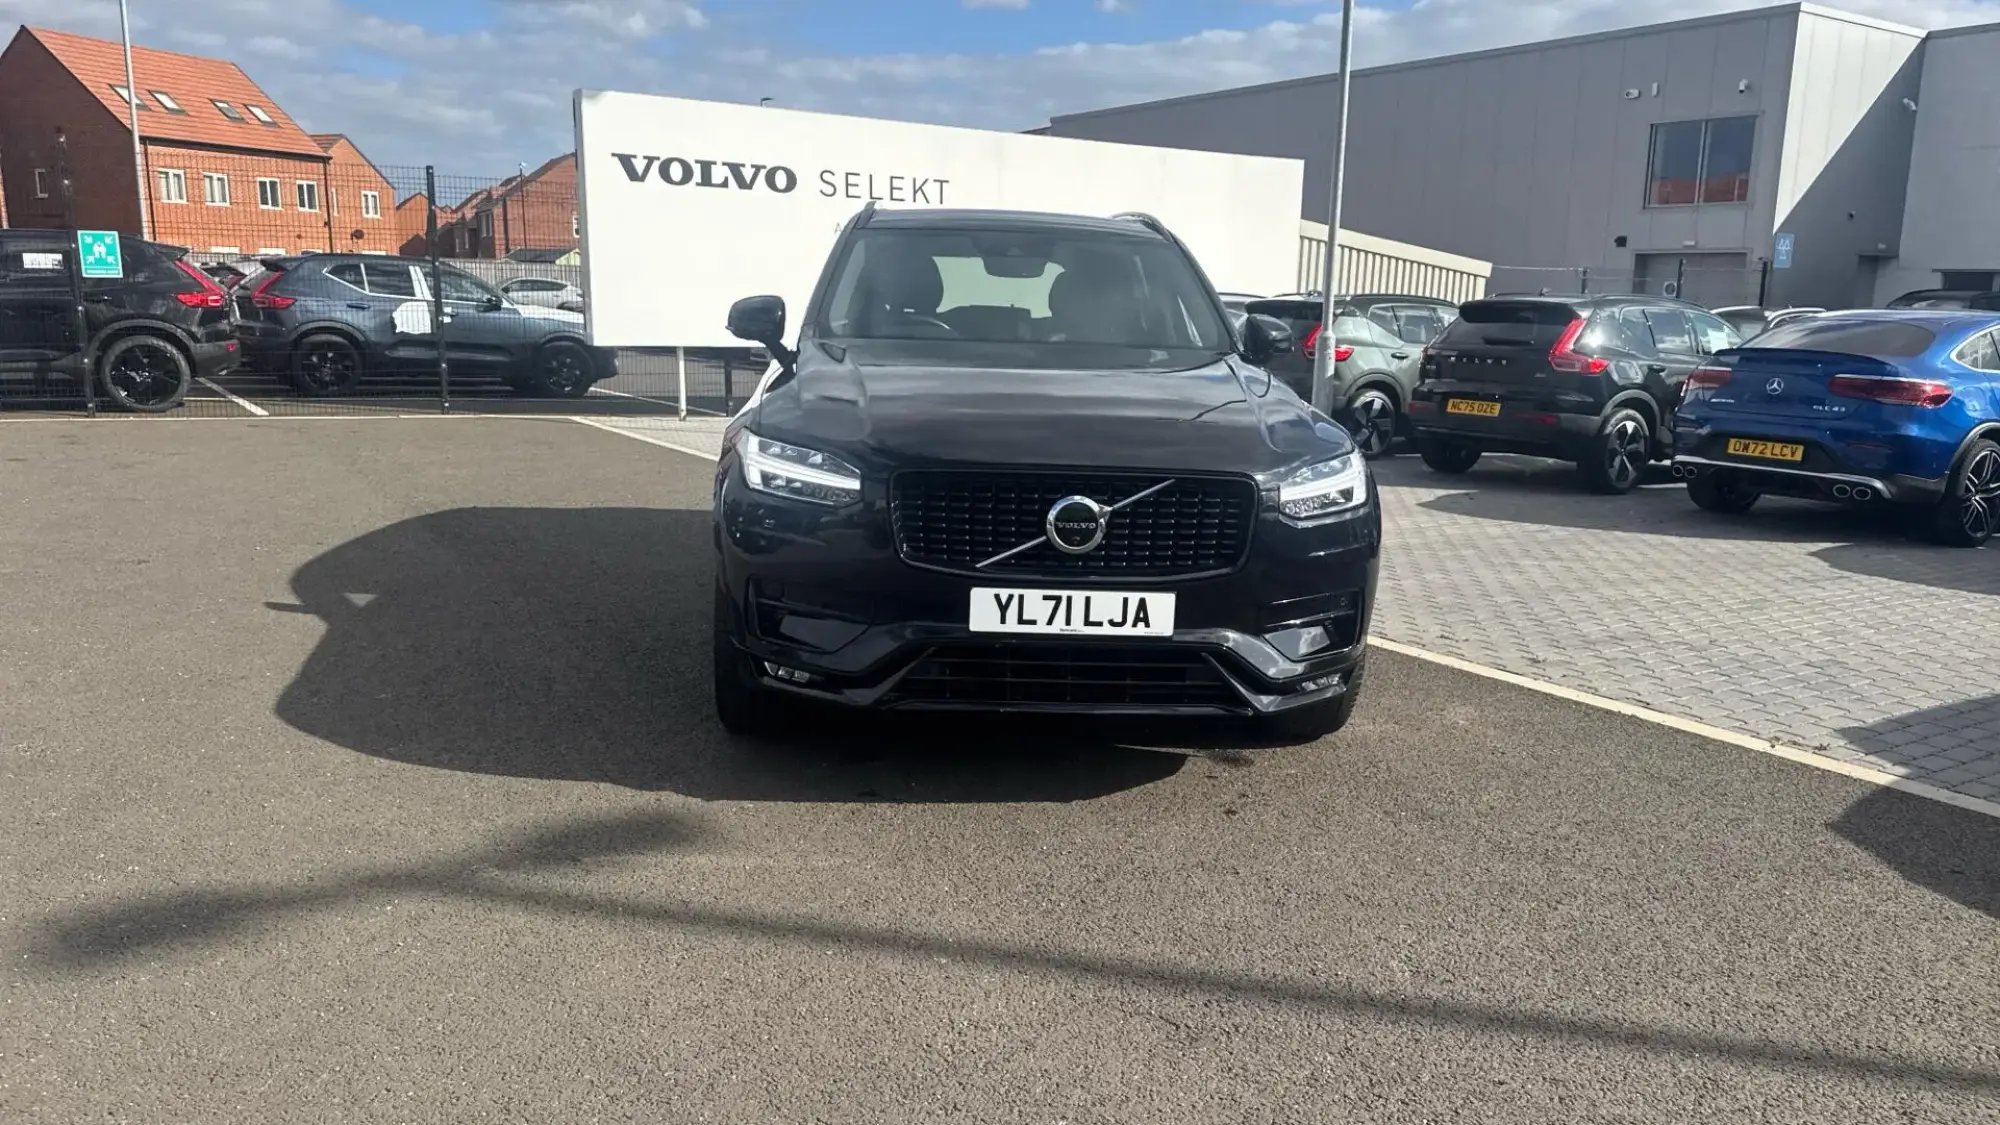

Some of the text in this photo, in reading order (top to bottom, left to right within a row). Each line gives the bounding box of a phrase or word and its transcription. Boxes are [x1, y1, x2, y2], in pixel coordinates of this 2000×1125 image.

[611, 152, 950, 205] VOLVO SELEKT
[1770, 443, 1798, 458] LCV
[1055, 521, 1097, 529] VOLVO
[994, 593, 1151, 628] YL71 LJA
